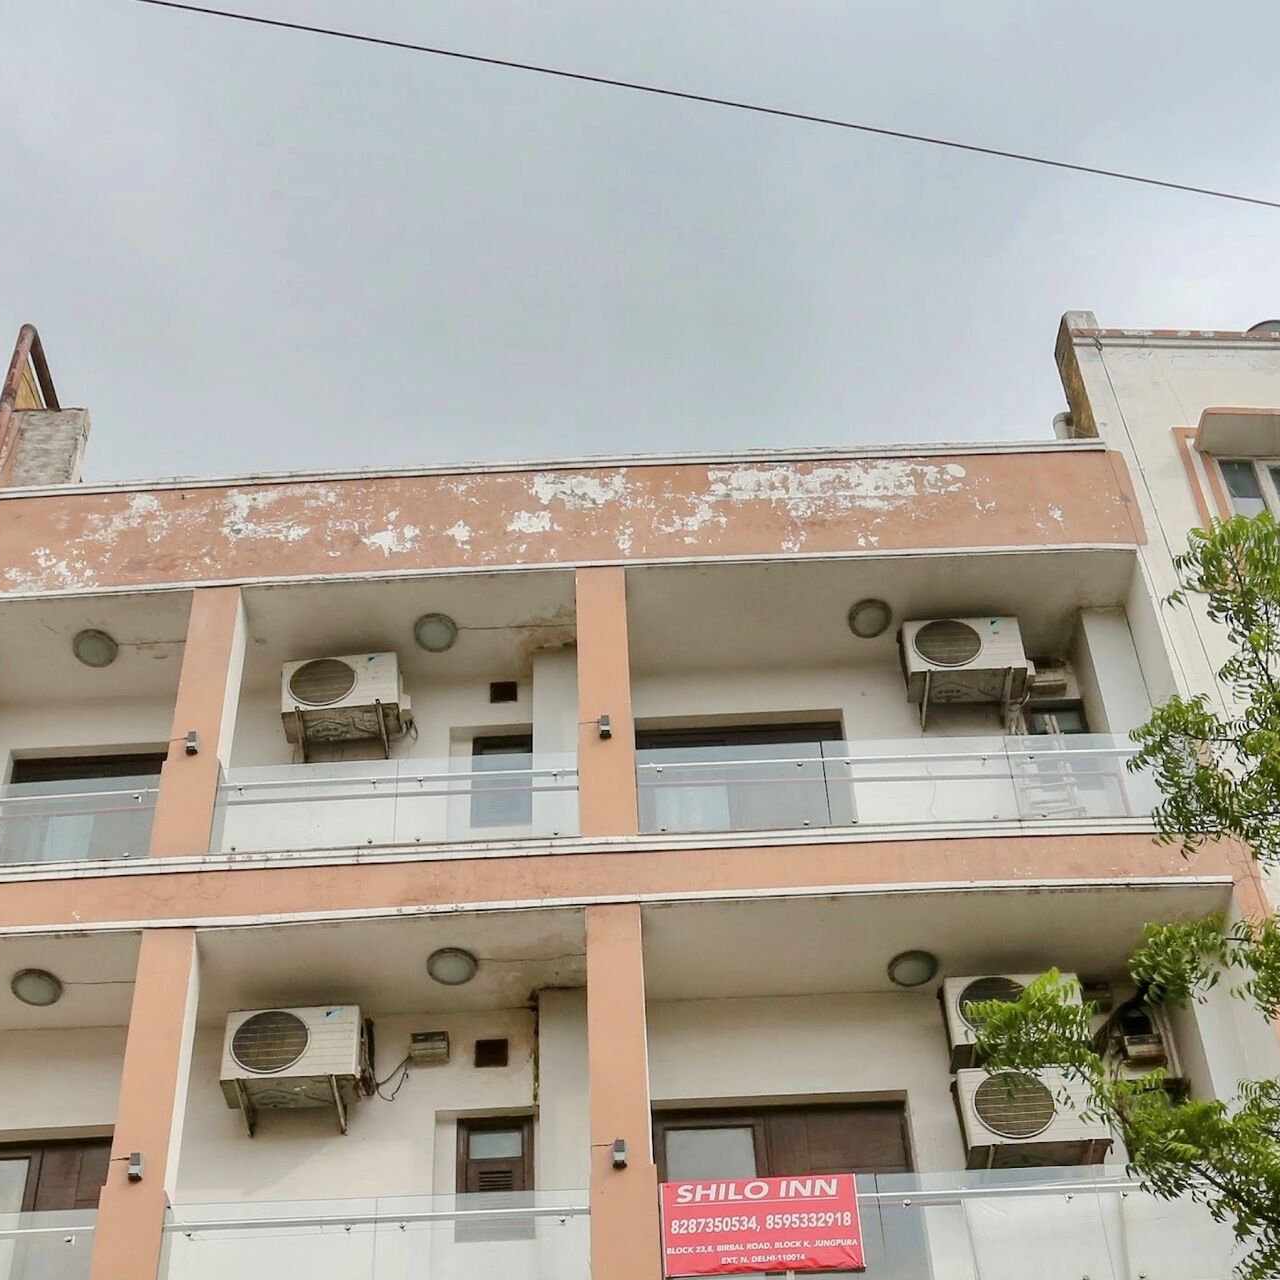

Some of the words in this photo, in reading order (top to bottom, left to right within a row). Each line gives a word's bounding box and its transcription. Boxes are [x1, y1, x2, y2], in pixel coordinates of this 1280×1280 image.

[676, 1181, 768, 1203] SHILO
[779, 1178, 838, 1198] INN
[671, 1216, 761, 1234] 8287350534,
[765, 1212, 852, 1229] 8595332918
[666, 1246, 694, 1256] BLOCK
[716, 1243, 745, 1252] BIRBAL
[774, 1239, 802, 1249] BLOCK
[813, 1238, 858, 1248] JUNGPURA
[740, 1255, 750, 1265] N.
[751, 1253, 806, 1264] DELHI-110014
